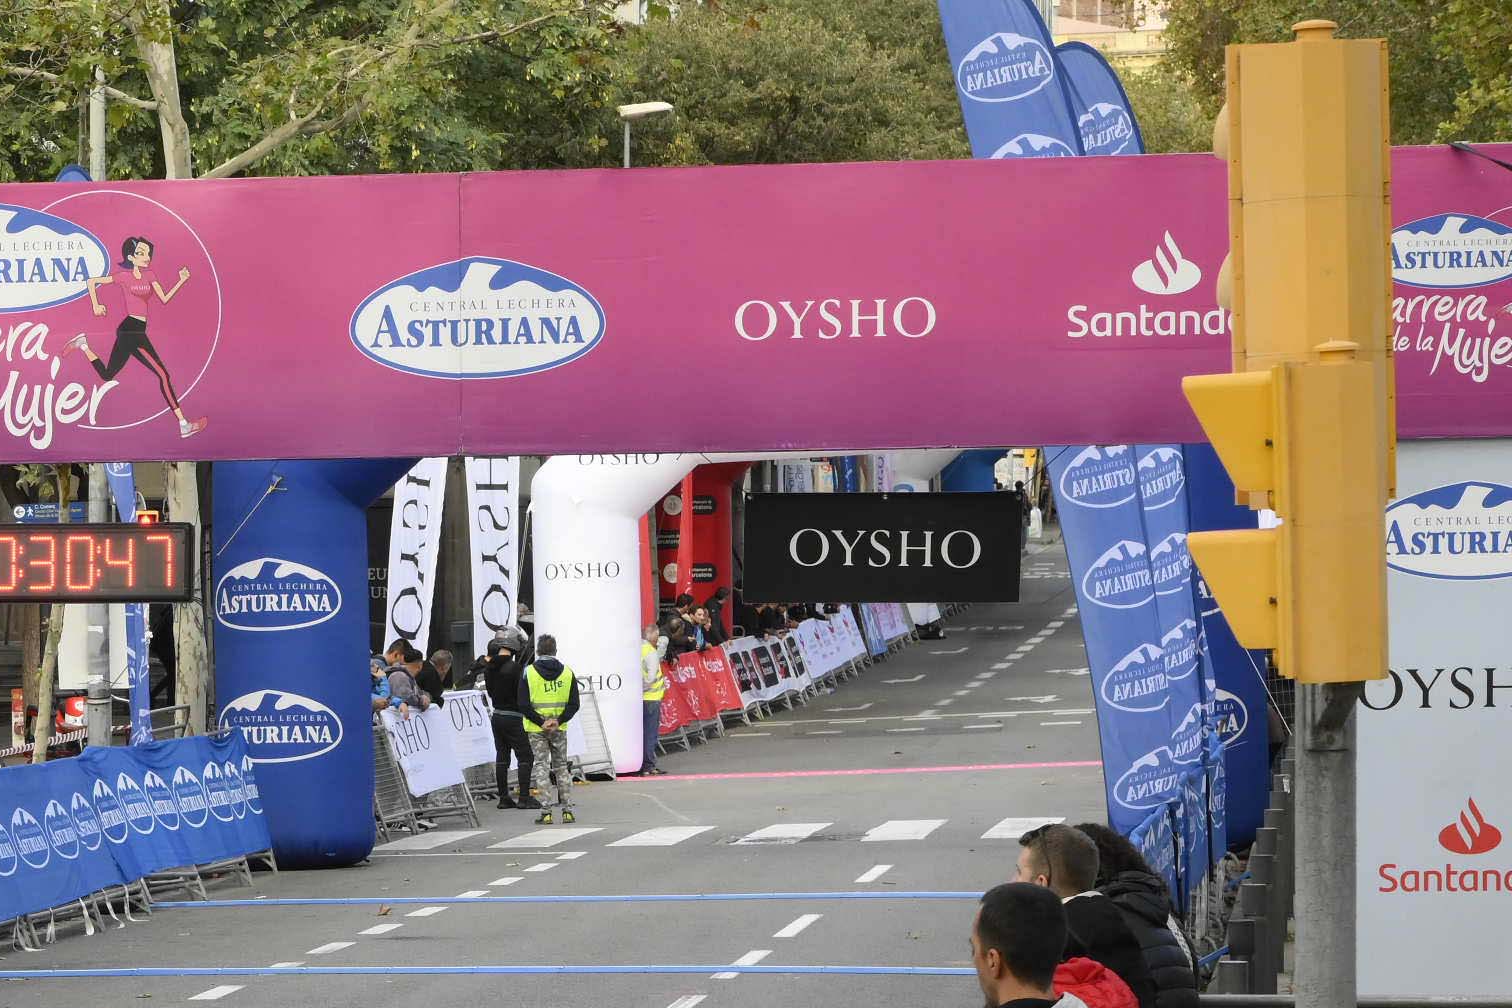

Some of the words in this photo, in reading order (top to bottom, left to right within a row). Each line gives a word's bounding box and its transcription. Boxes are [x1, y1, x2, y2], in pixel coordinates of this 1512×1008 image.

[13, 239, 85, 252] LECHERA
[1406, 239, 1457, 248] CENTRAL
[409, 300, 488, 312] CENTRAL
[496, 298, 576, 310] LECHERA
[1392, 294, 1488, 323] arrera
[370, 304, 586, 349] ASTURIANA
[734, 296, 937, 341] OYSHO
[1416, 323, 1434, 351] la
[1413, 516, 1481, 526] CENTRAL
[789, 528, 981, 569] OYSHO
[545, 561, 621, 581] OYSHO
[232, 583, 274, 592] CENTRAL
[279, 582, 327, 590] LECHERA
[219, 588, 333, 615] ASTURIANA
[544, 680, 563, 692] Life
[234, 714, 275, 723] CENTRAL
[279, 714, 328, 722] LECHERA
